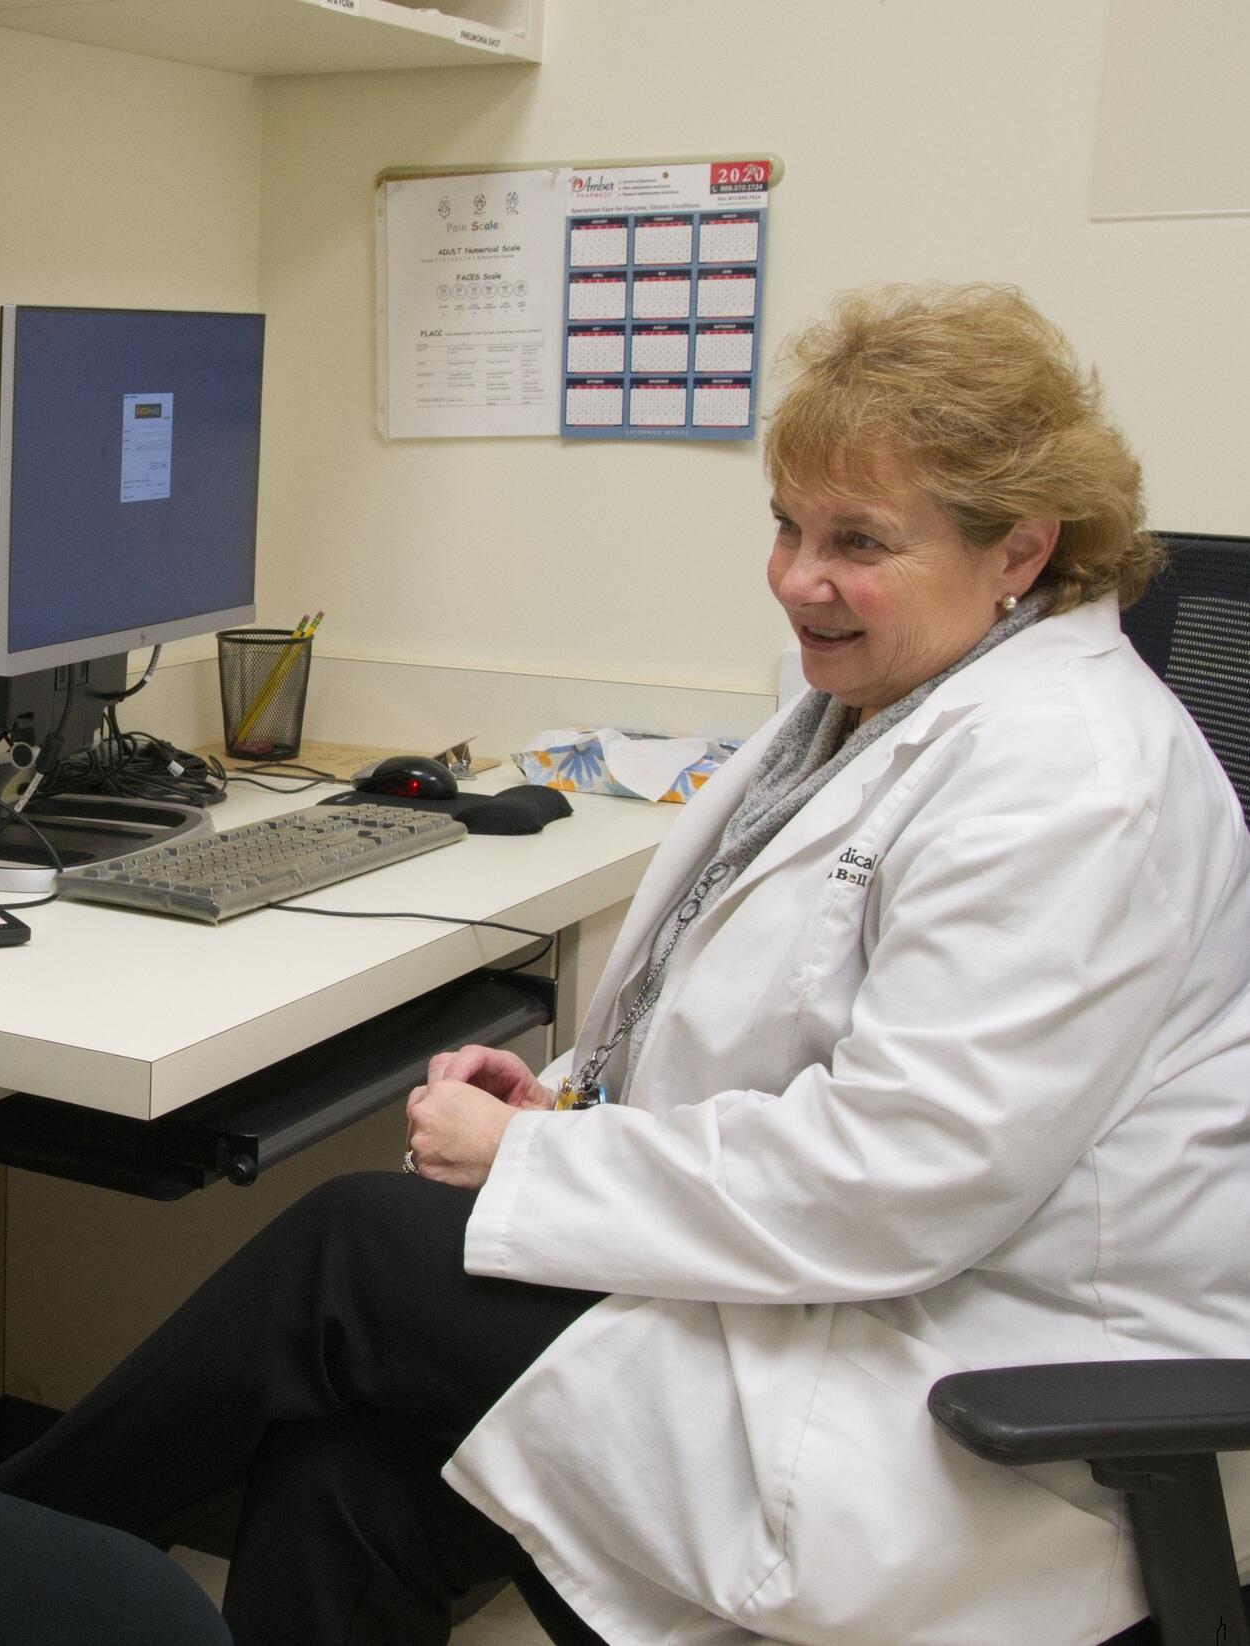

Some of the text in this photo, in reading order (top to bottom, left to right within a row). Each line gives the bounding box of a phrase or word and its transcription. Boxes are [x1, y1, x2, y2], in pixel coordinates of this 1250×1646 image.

[718, 166, 764, 183] 2020
[581, 175, 614, 192] Amber
[446, 222, 466, 232] Pain
[438, 244, 521, 255] ADULT Numerical Scale
[484, 272, 502, 280] Scale
[840, 848, 878, 870] dical
